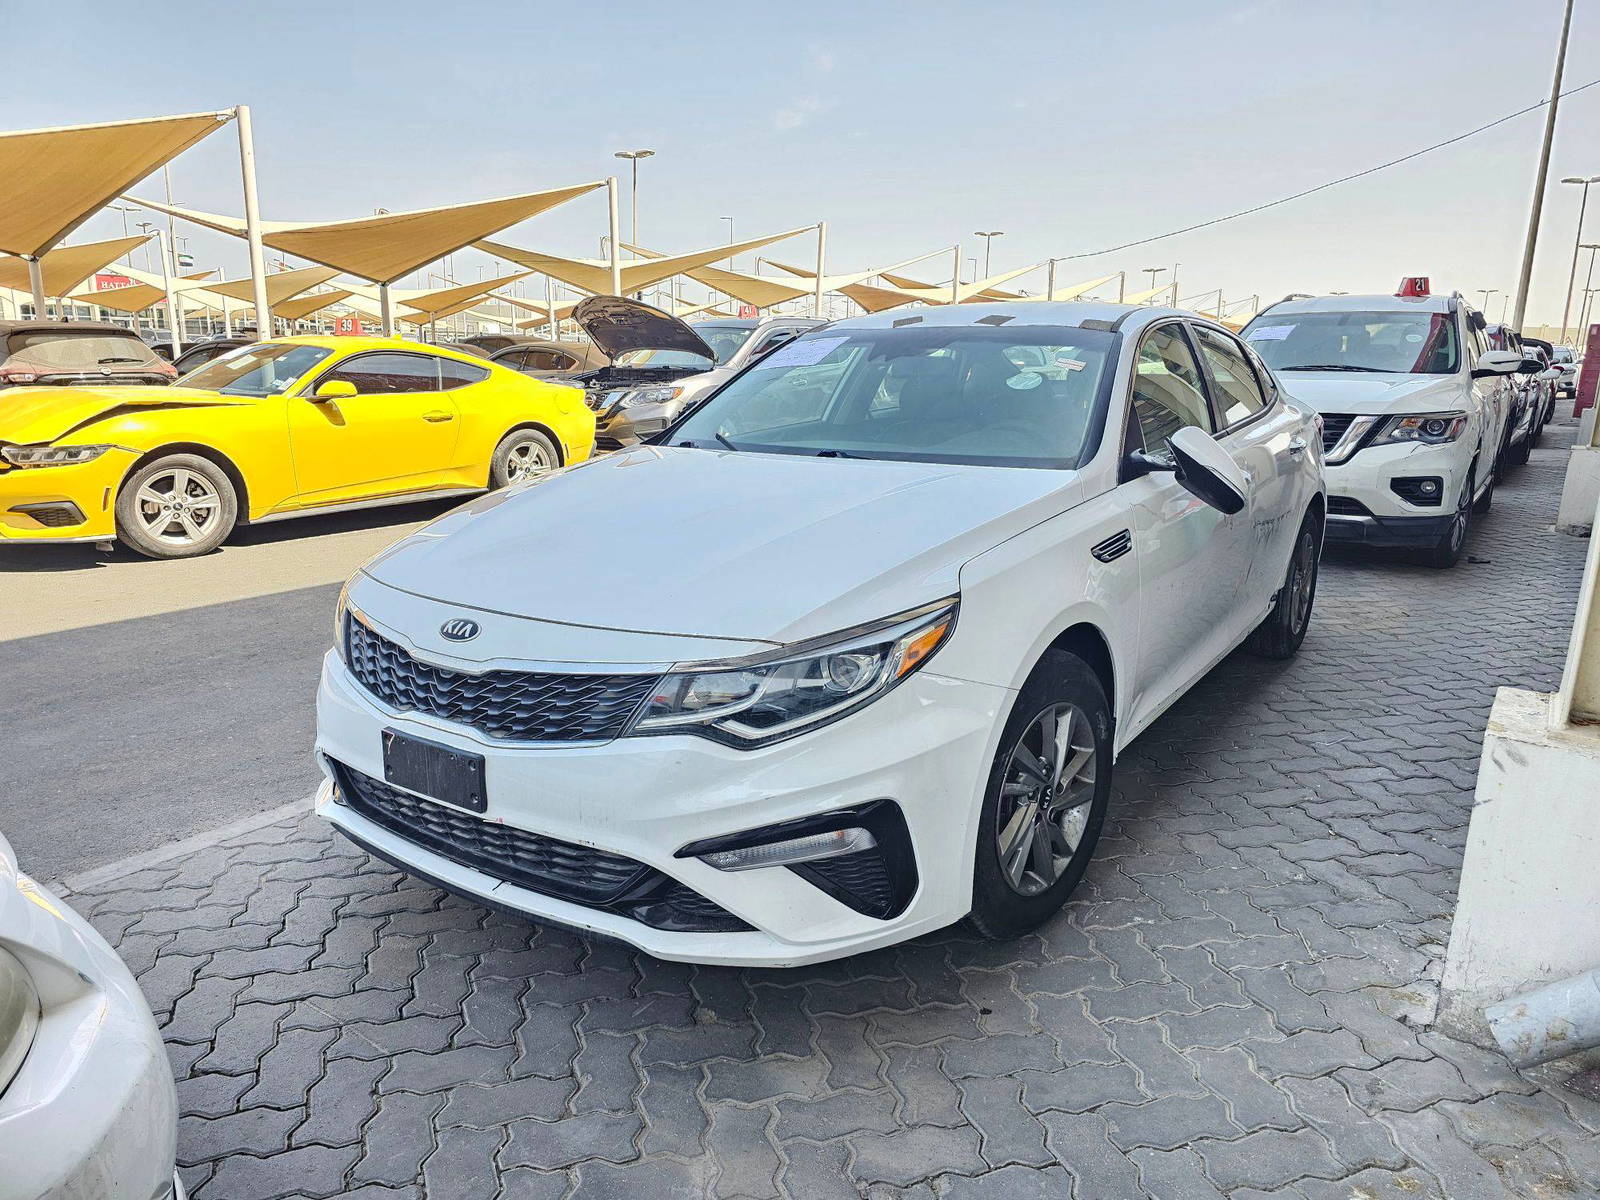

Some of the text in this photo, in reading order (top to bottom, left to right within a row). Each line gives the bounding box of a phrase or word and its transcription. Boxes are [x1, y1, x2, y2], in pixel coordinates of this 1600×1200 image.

[1415, 278, 1425, 292] 21
[341, 319, 352, 332] 39
[443, 619, 474, 638] KIA
[1042, 788, 1052, 809] KIA
